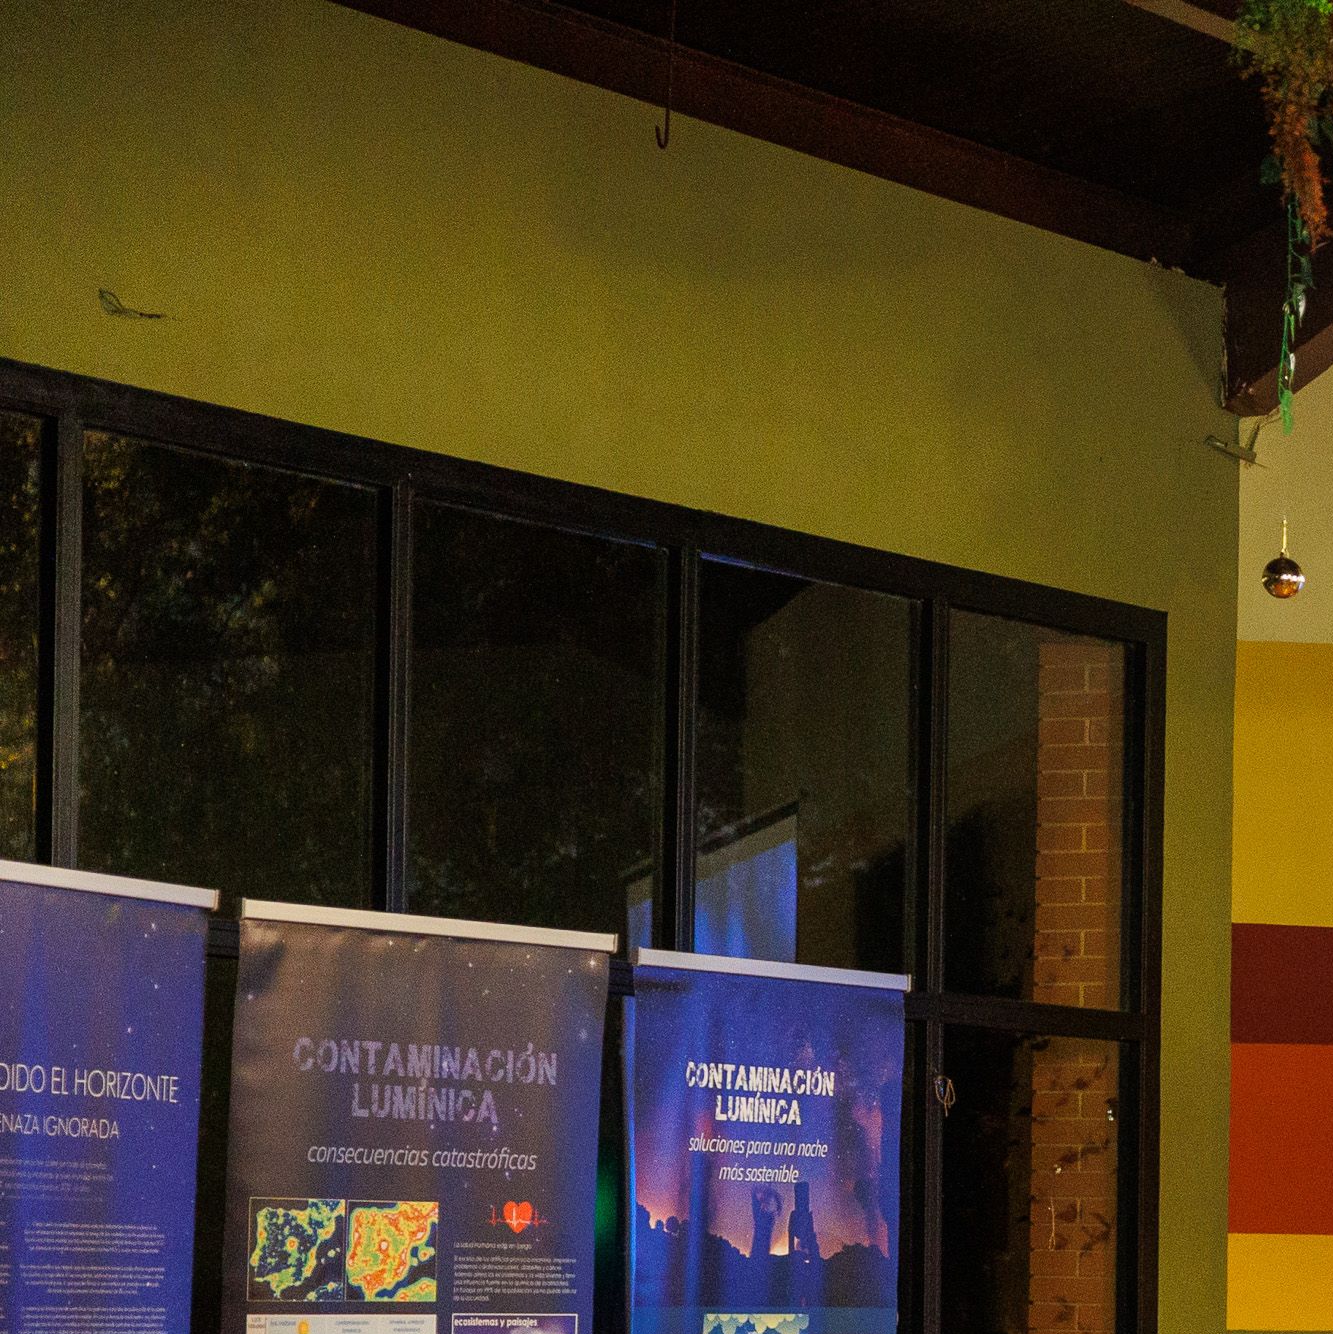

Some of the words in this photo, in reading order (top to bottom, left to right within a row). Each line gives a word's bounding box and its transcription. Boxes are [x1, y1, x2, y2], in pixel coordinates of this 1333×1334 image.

[293, 1037, 557, 1086] CONTAMINACIÓN
[0, 1063, 46, 1093] DIDO
[51, 1067, 68, 1095] EL
[74, 1069, 179, 1103] HORIZONTE
[686, 1061, 835, 1097] CONTAMINACIÓN
[351, 1078, 499, 1124] LUMÍNICA
[715, 1092, 801, 1125] LUMÍNICA
[0, 1113, 40, 1135] NAZA
[43, 1115, 119, 1139] IGNORADA
[307, 1145, 429, 1167] consecuencias
[431, 1147, 537, 1171] catastróficas
[688, 1133, 745, 1154] soluciones
[745, 1140, 771, 1158] para
[773, 1141, 796, 1156] una
[797, 1139, 828, 1158] noche
[719, 1164, 744, 1181] más
[745, 1164, 799, 1183] sostenible
[454, 1319, 498, 1328] ecosistemas
[506, 1318, 537, 1329] paisajes
